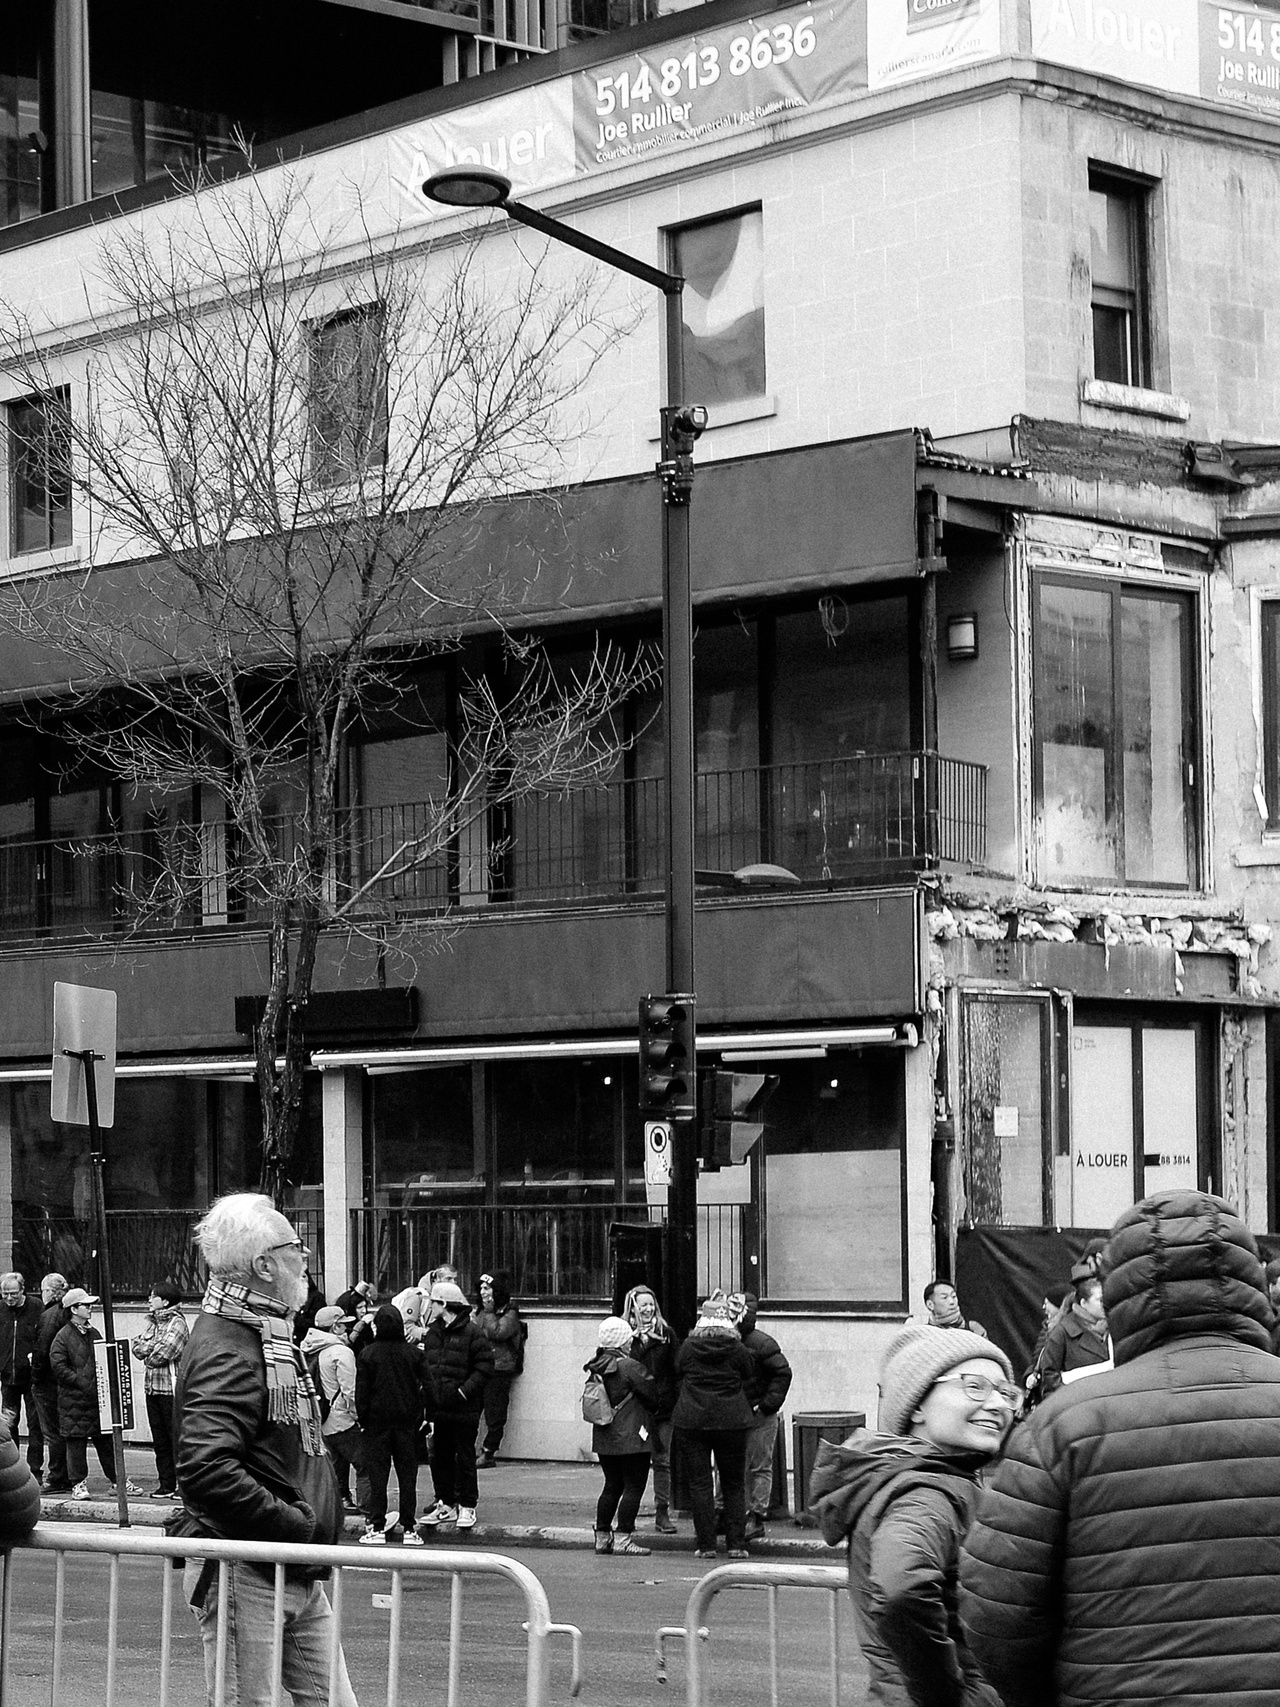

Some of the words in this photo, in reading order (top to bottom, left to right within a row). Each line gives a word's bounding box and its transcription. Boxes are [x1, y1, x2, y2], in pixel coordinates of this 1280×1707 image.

[1218, 8, 1265, 57] 514
[595, 64, 653, 116] 514
[660, 45, 721, 97] 813
[729, 15, 817, 76] 8636
[1218, 55, 1245, 83] Joe
[1247, 61, 1280, 91] Rulli
[595, 121, 628, 150] Joe
[631, 101, 694, 135] Rullier
[595, 145, 633, 163] Courtier
[678, 114, 732, 141] commercial
[738, 109, 756, 125] Joe
[756, 98, 784, 118] Rullier
[1076, 1150, 1085, 1167] À
[1088, 1153, 1128, 1167] LOUER
